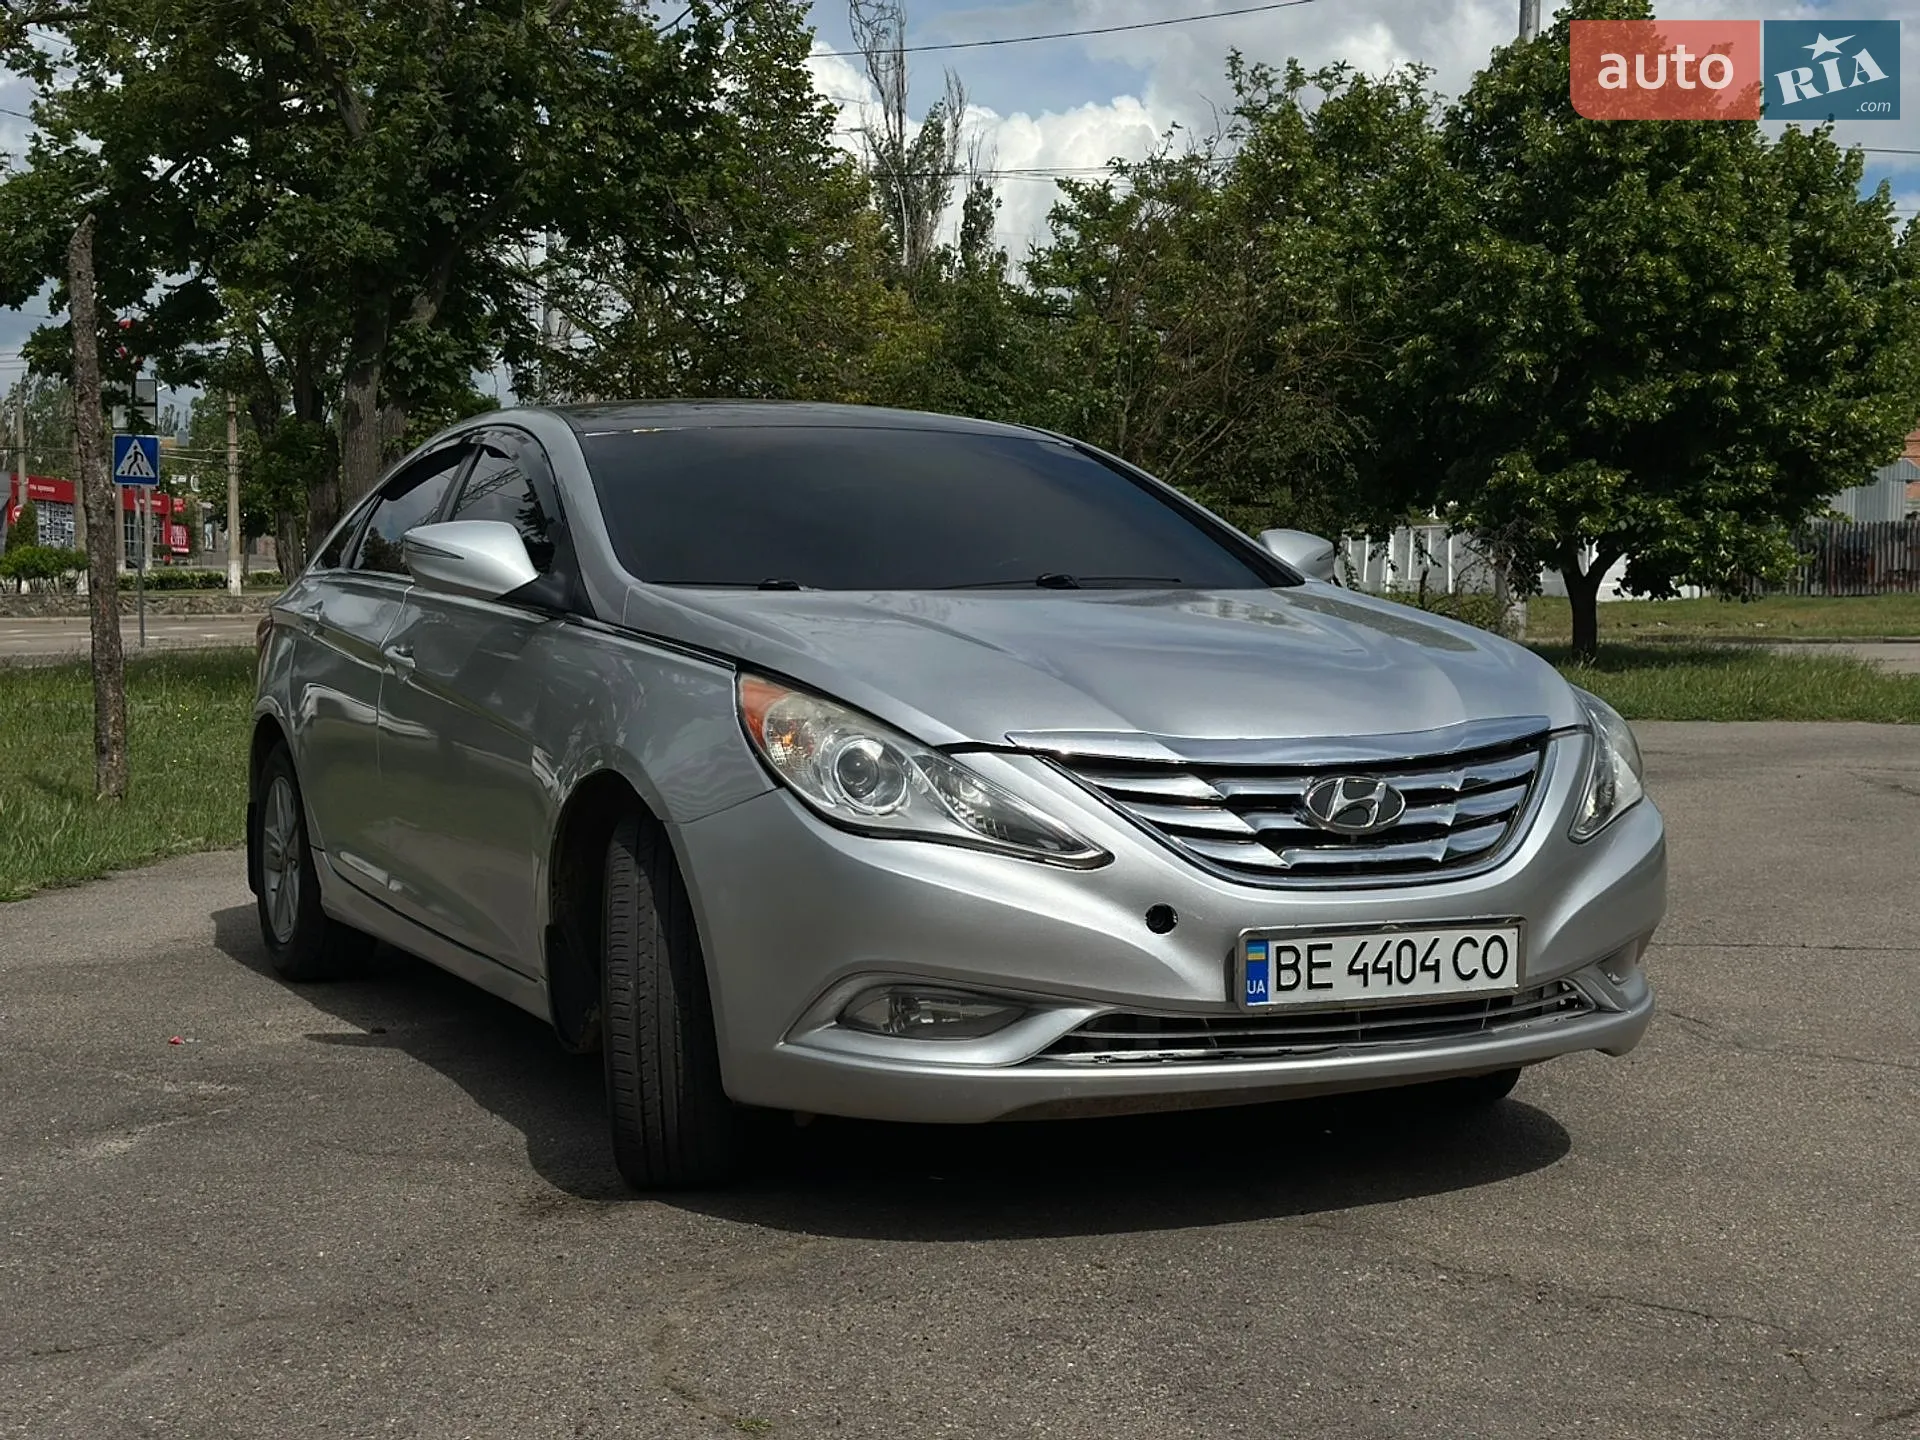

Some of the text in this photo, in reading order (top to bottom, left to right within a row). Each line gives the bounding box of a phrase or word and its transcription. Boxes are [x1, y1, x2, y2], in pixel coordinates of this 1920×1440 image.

[1275, 934, 1509, 992] BE 4404 CO
[1246, 980, 1266, 995] UA
